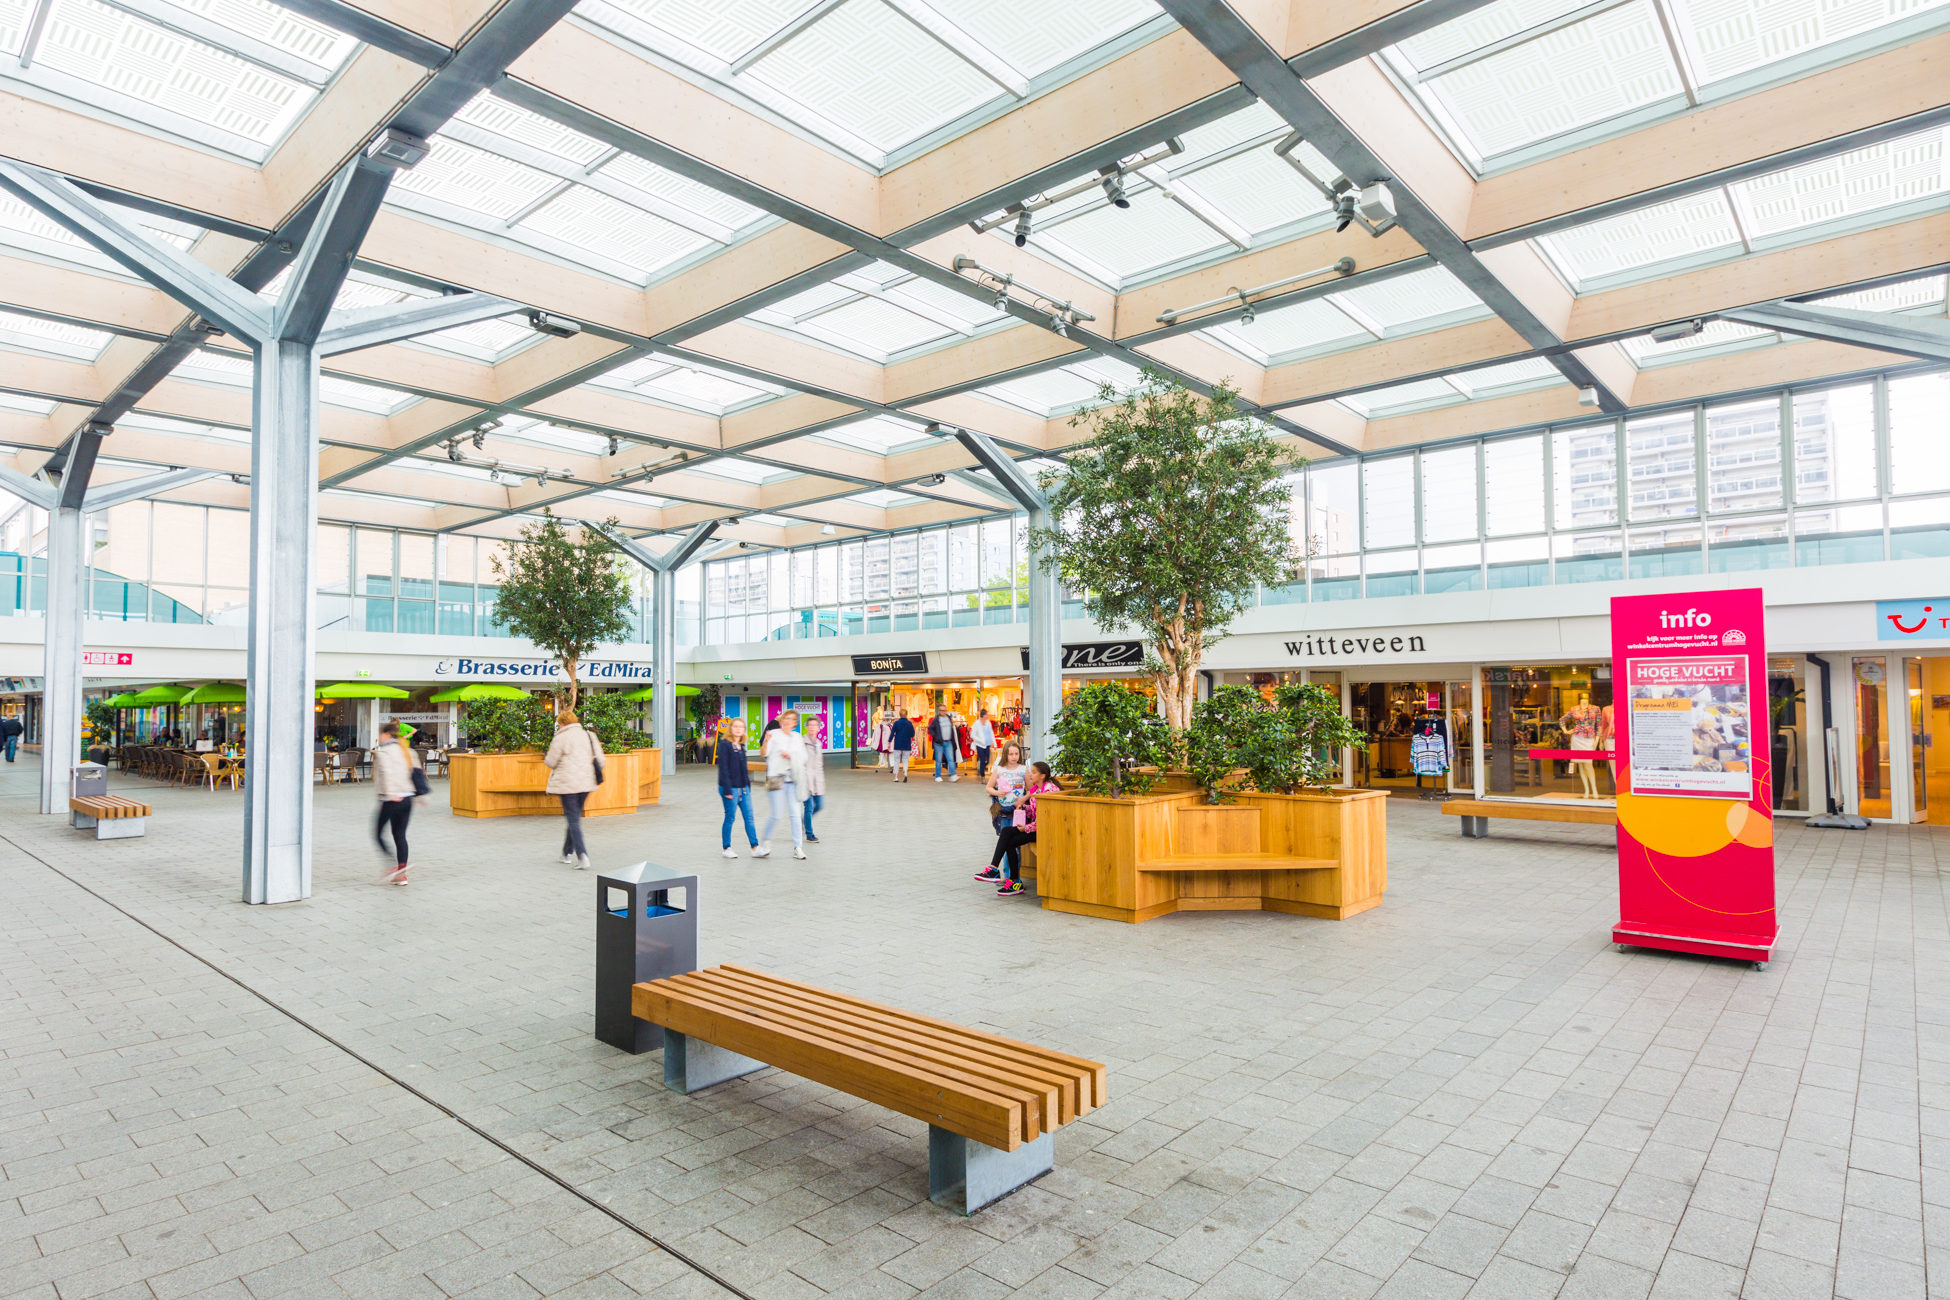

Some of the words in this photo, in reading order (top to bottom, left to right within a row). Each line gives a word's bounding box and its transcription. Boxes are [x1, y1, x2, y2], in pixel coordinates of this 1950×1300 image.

[1659, 608, 1712, 628] info
[1284, 634, 1427, 656] witteveen
[1627, 641, 1718, 649] winkelcentrumhogevucht.nl
[1646, 635, 1659, 643] kijk
[1062, 644, 1139, 667] ne
[457, 658, 560, 676] Brasserie
[588, 662, 652, 678] EdMira
[870, 658, 903, 671] BONITA
[1637, 667, 1678, 678] HOGE
[1682, 665, 1735, 677] VUCHT
